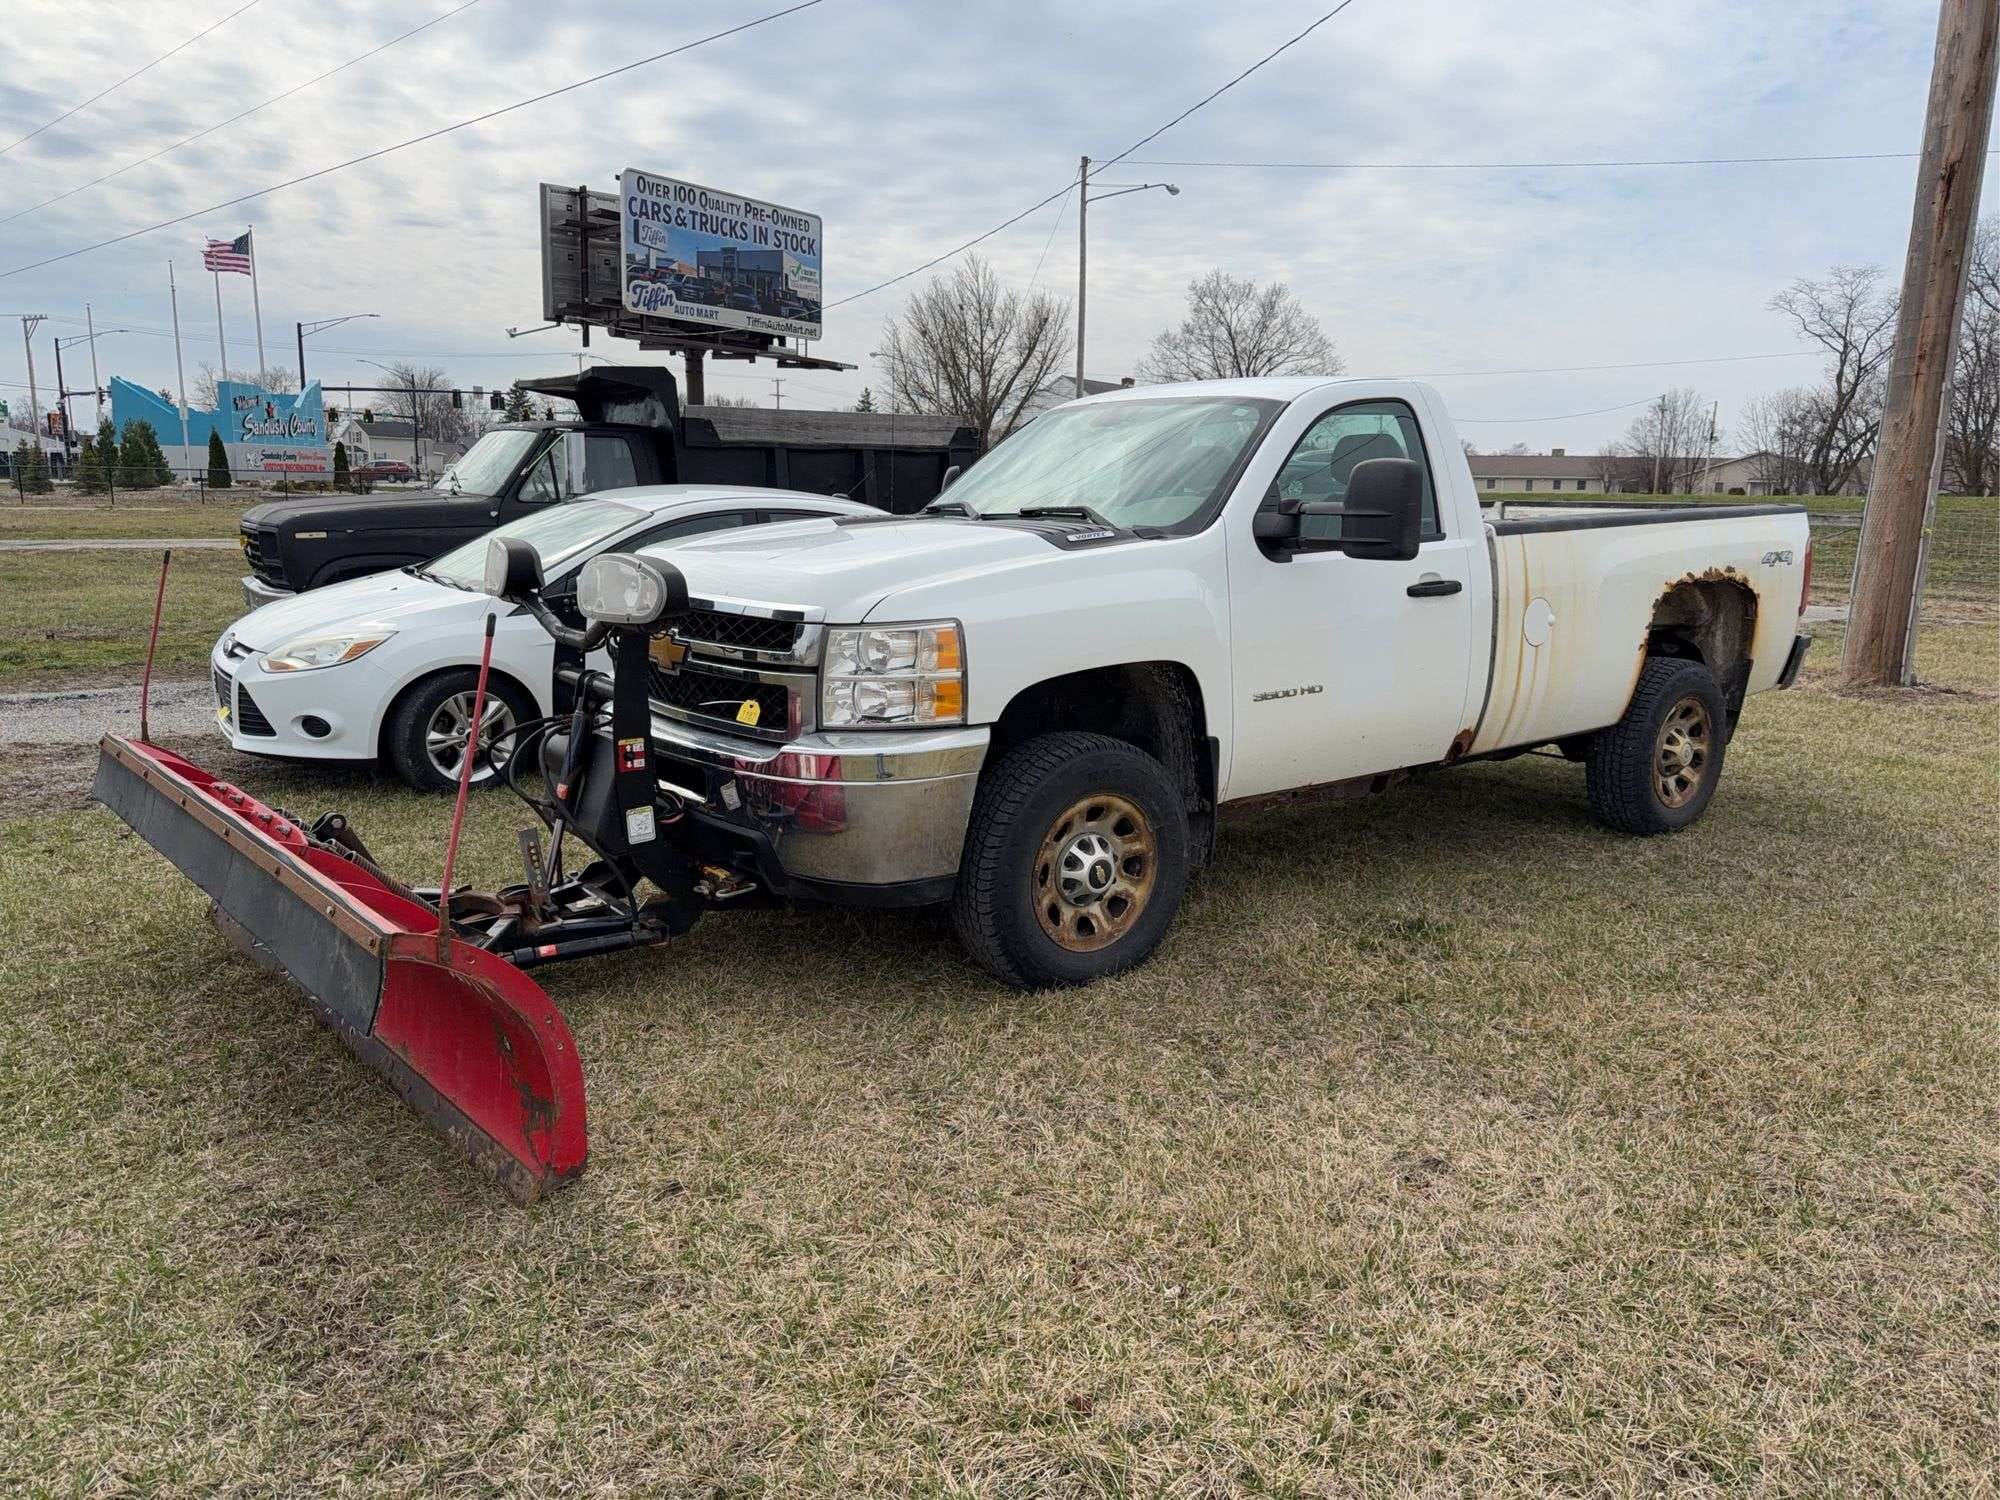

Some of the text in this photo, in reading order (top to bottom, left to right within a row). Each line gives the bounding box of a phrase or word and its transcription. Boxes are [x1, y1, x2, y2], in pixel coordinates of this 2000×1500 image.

[673, 184, 696, 205] 100
[641, 224, 667, 244] Tiffin
[752, 224, 768, 246] IN
[773, 229, 816, 256] STOCK
[631, 284, 675, 311] Tiffin
[674, 304, 719, 320] AUTO MART
[746, 316, 817, 337] TiffinAutoMart.net
[241, 412, 318, 441] Sandusky County
[1300, 685, 1323, 696] HD
